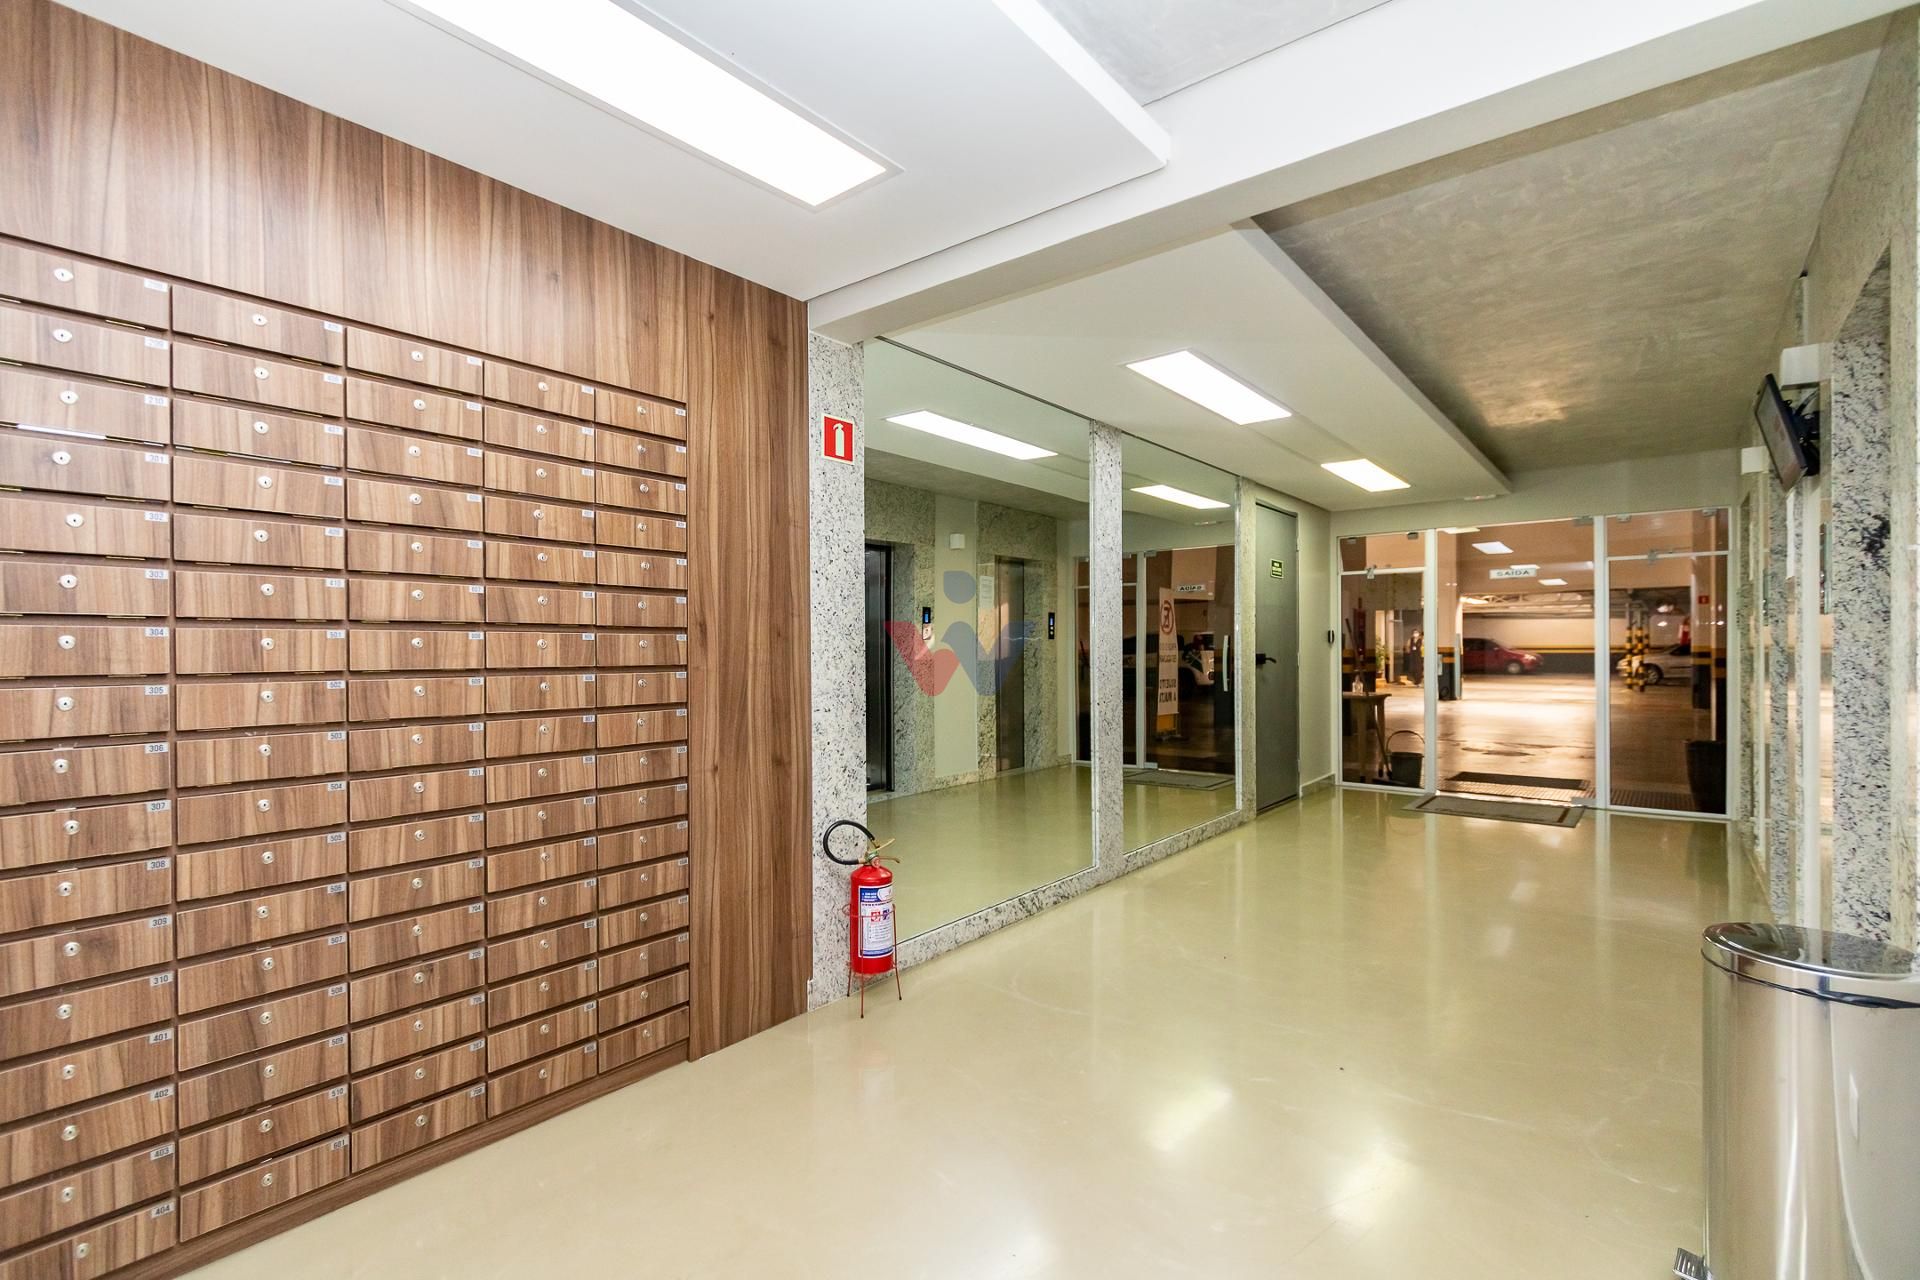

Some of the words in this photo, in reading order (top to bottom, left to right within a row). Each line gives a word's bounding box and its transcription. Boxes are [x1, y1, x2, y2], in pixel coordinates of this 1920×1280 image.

[149, 454, 164, 463] 301
[149, 512, 163, 520] 302
[149, 570, 164, 578] 303
[149, 744, 163, 752] 306
[151, 860, 165, 868] 308
[152, 918, 167, 926] 309
[331, 936, 342, 944] 507
[154, 975, 169, 984] 310
[153, 1033, 168, 1041] 401
[154, 1089, 169, 1099] 402
[331, 1088, 343, 1097] 510
[334, 1139, 345, 1149] 601
[154, 1148, 170, 1157] 403
[155, 1205, 170, 1215] 404
